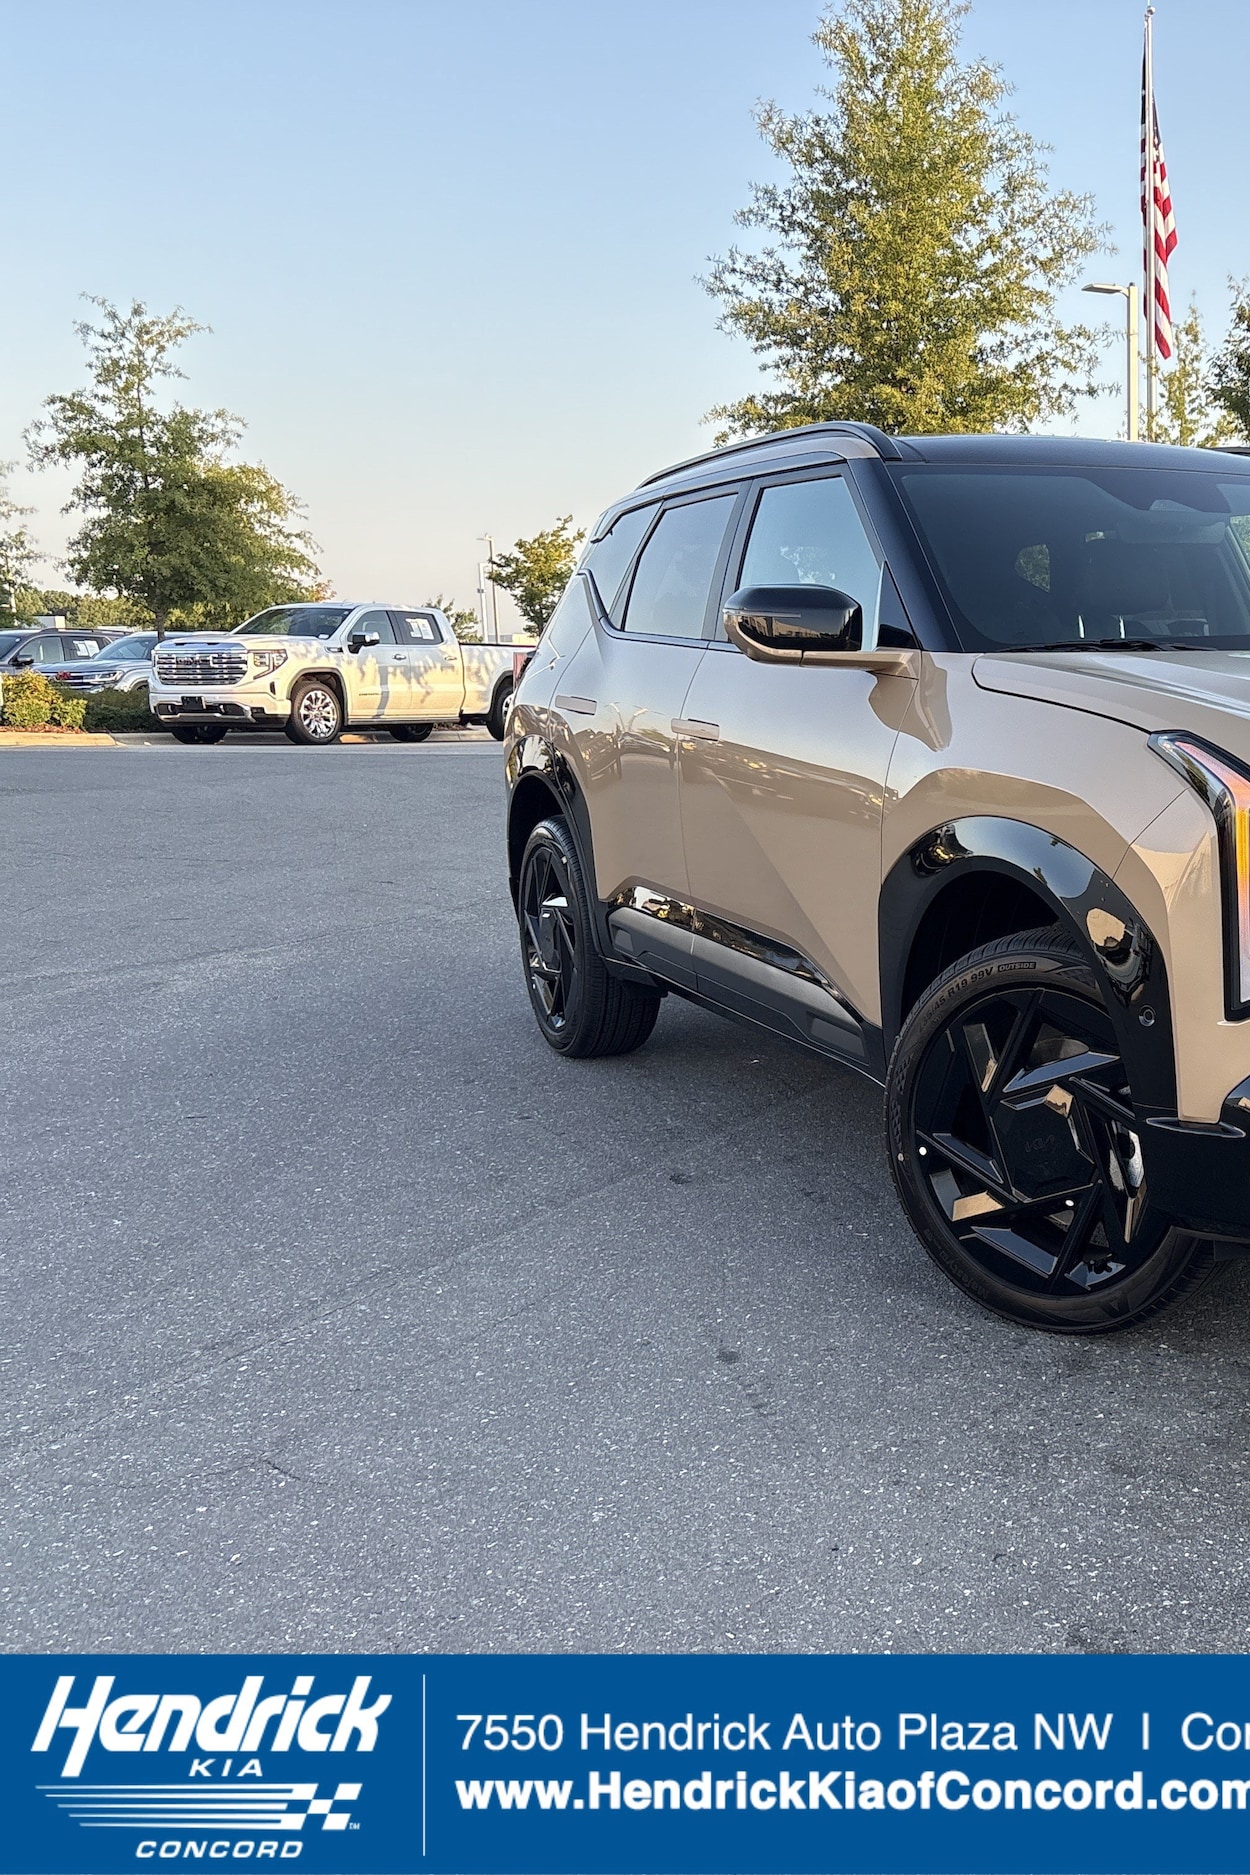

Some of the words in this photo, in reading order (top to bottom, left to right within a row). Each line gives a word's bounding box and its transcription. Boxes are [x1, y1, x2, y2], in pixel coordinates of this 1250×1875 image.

[948, 979, 969, 998] R19
[971, 966, 994, 984] 99V
[998, 962, 1036, 973] OUTSIDE
